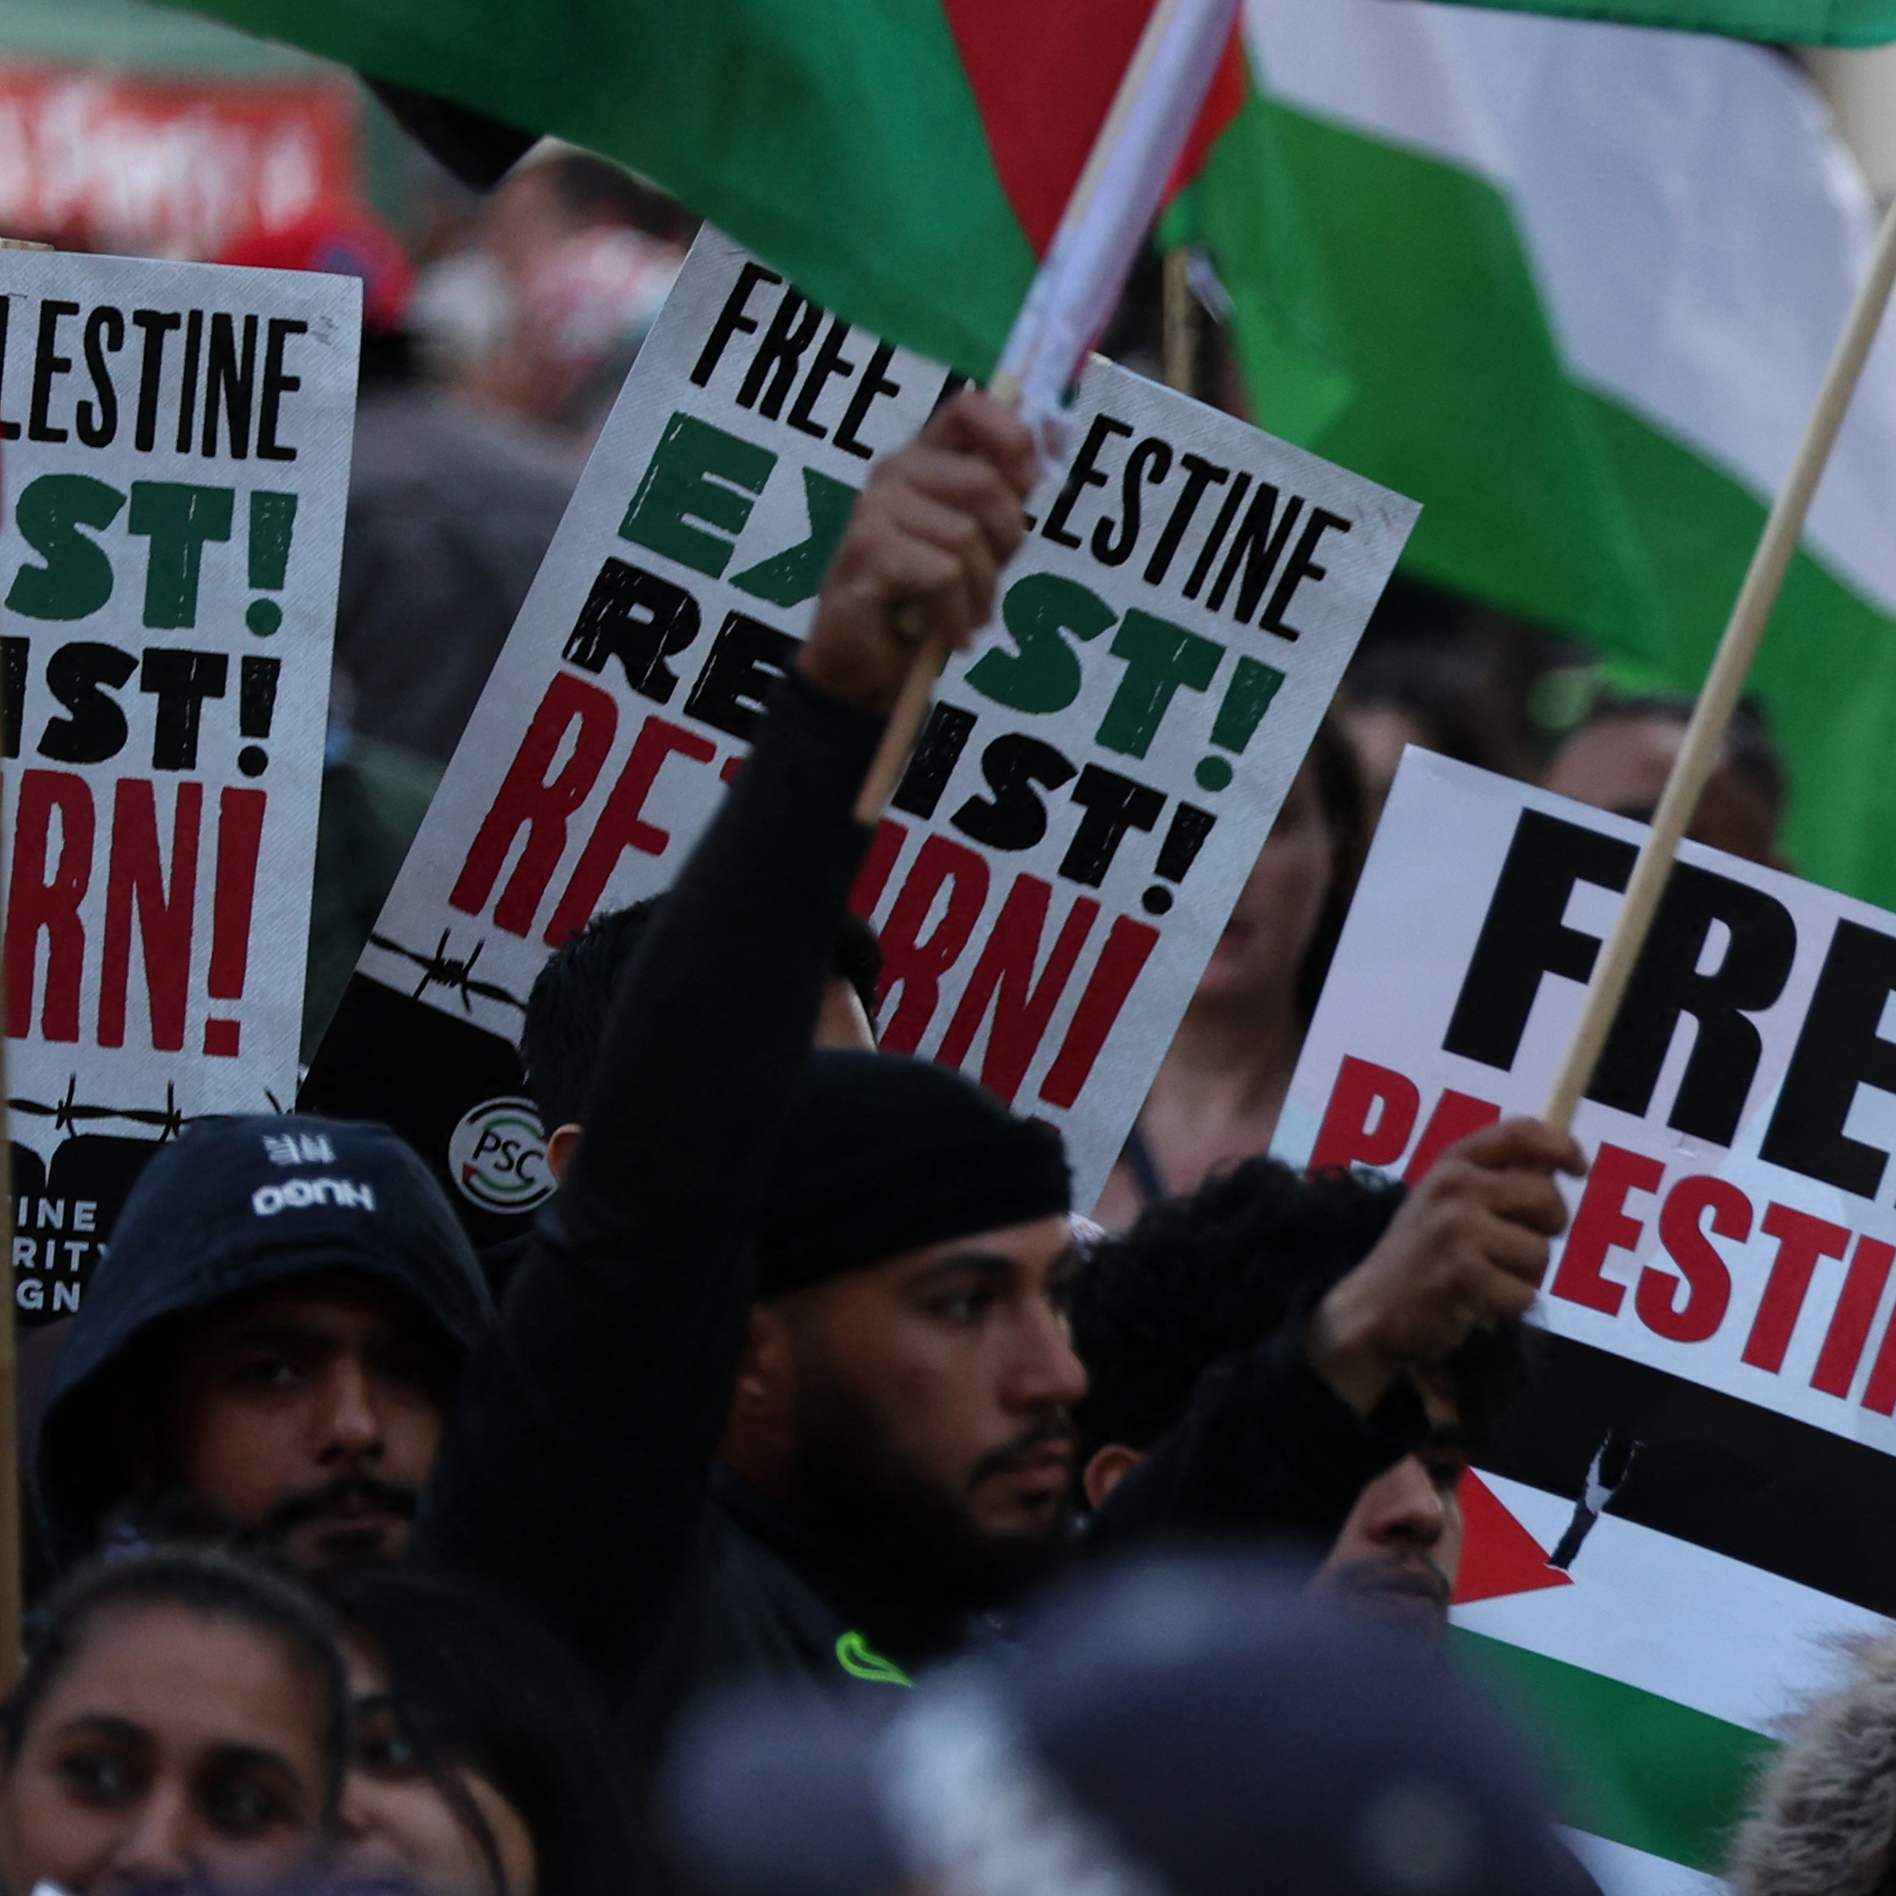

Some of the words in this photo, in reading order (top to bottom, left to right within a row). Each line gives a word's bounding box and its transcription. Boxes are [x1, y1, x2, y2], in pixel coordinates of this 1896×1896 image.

[689, 261, 900, 461] FREE
[561, 556, 1217, 915] REIST!
[472, 1129, 544, 1183] PSC
